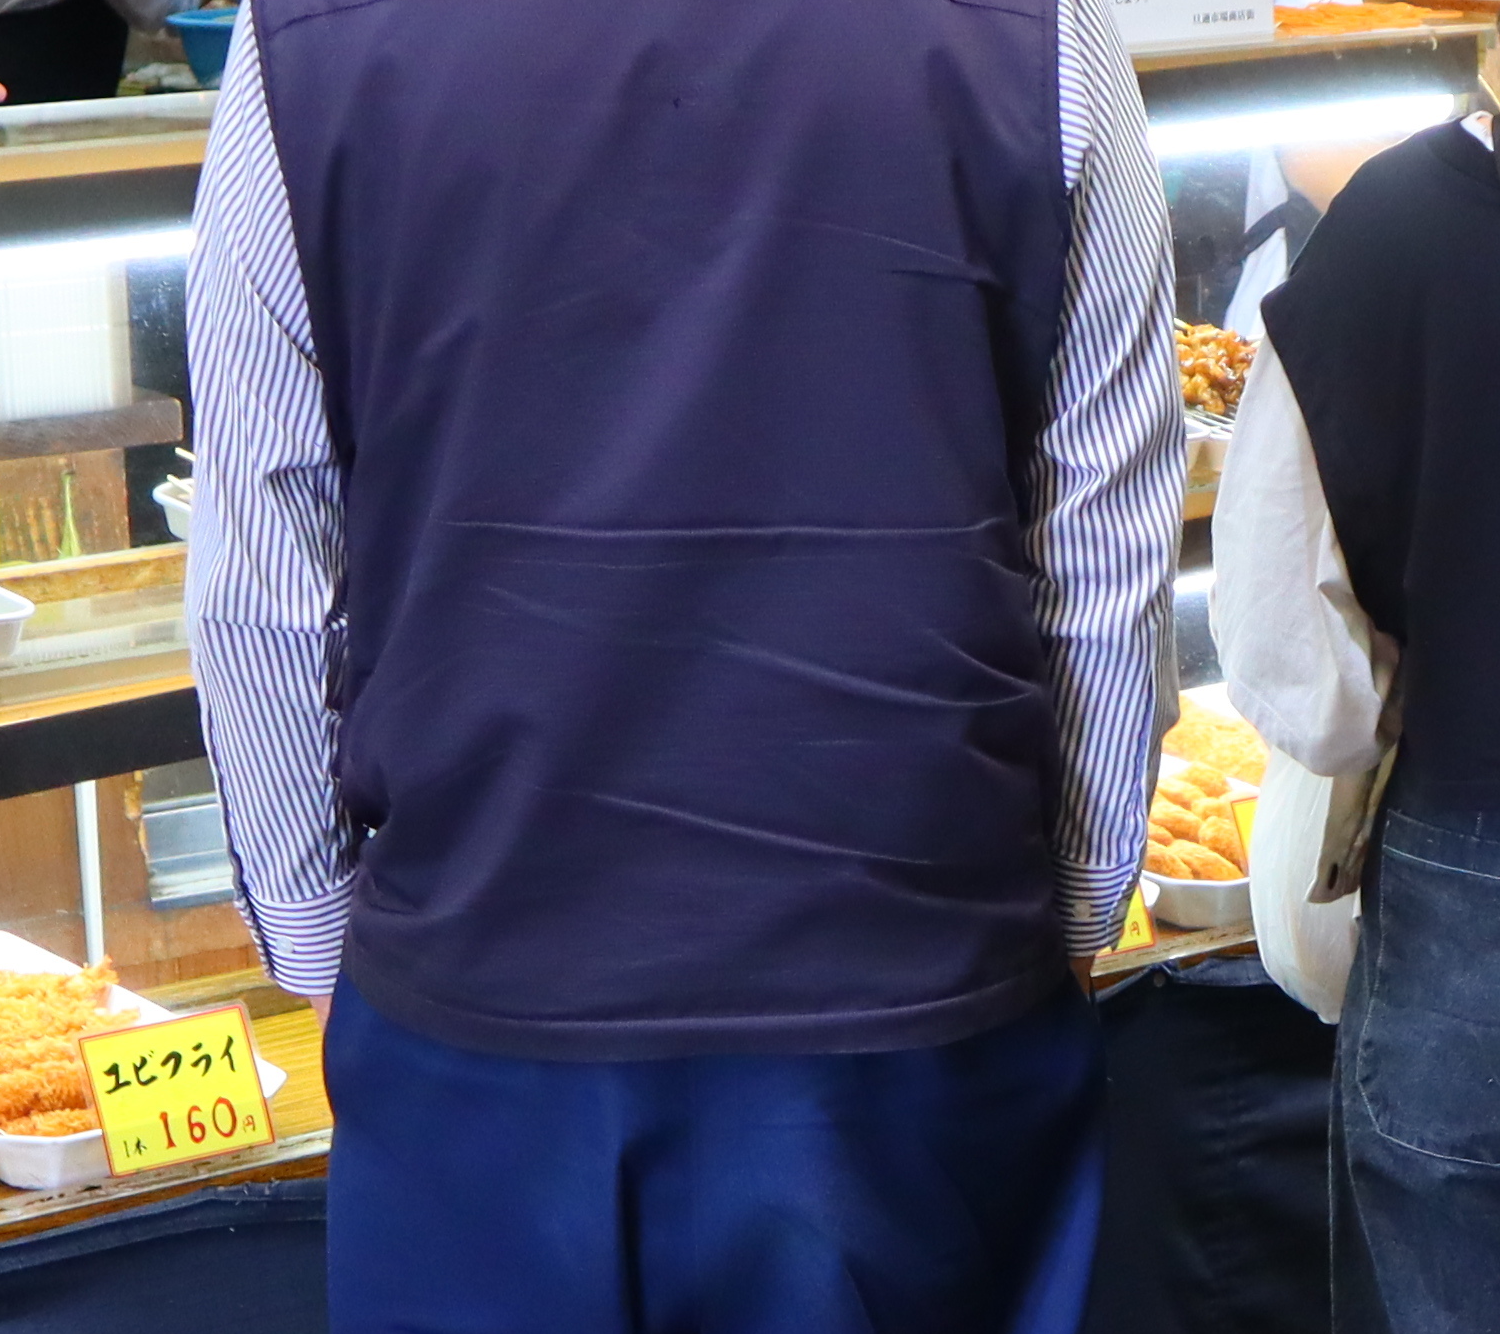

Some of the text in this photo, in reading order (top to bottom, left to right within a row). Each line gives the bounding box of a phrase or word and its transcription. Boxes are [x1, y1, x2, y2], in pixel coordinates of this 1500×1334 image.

[103, 1034, 236, 1095] エビフライ
[159, 1096, 256, 1150] 160円
